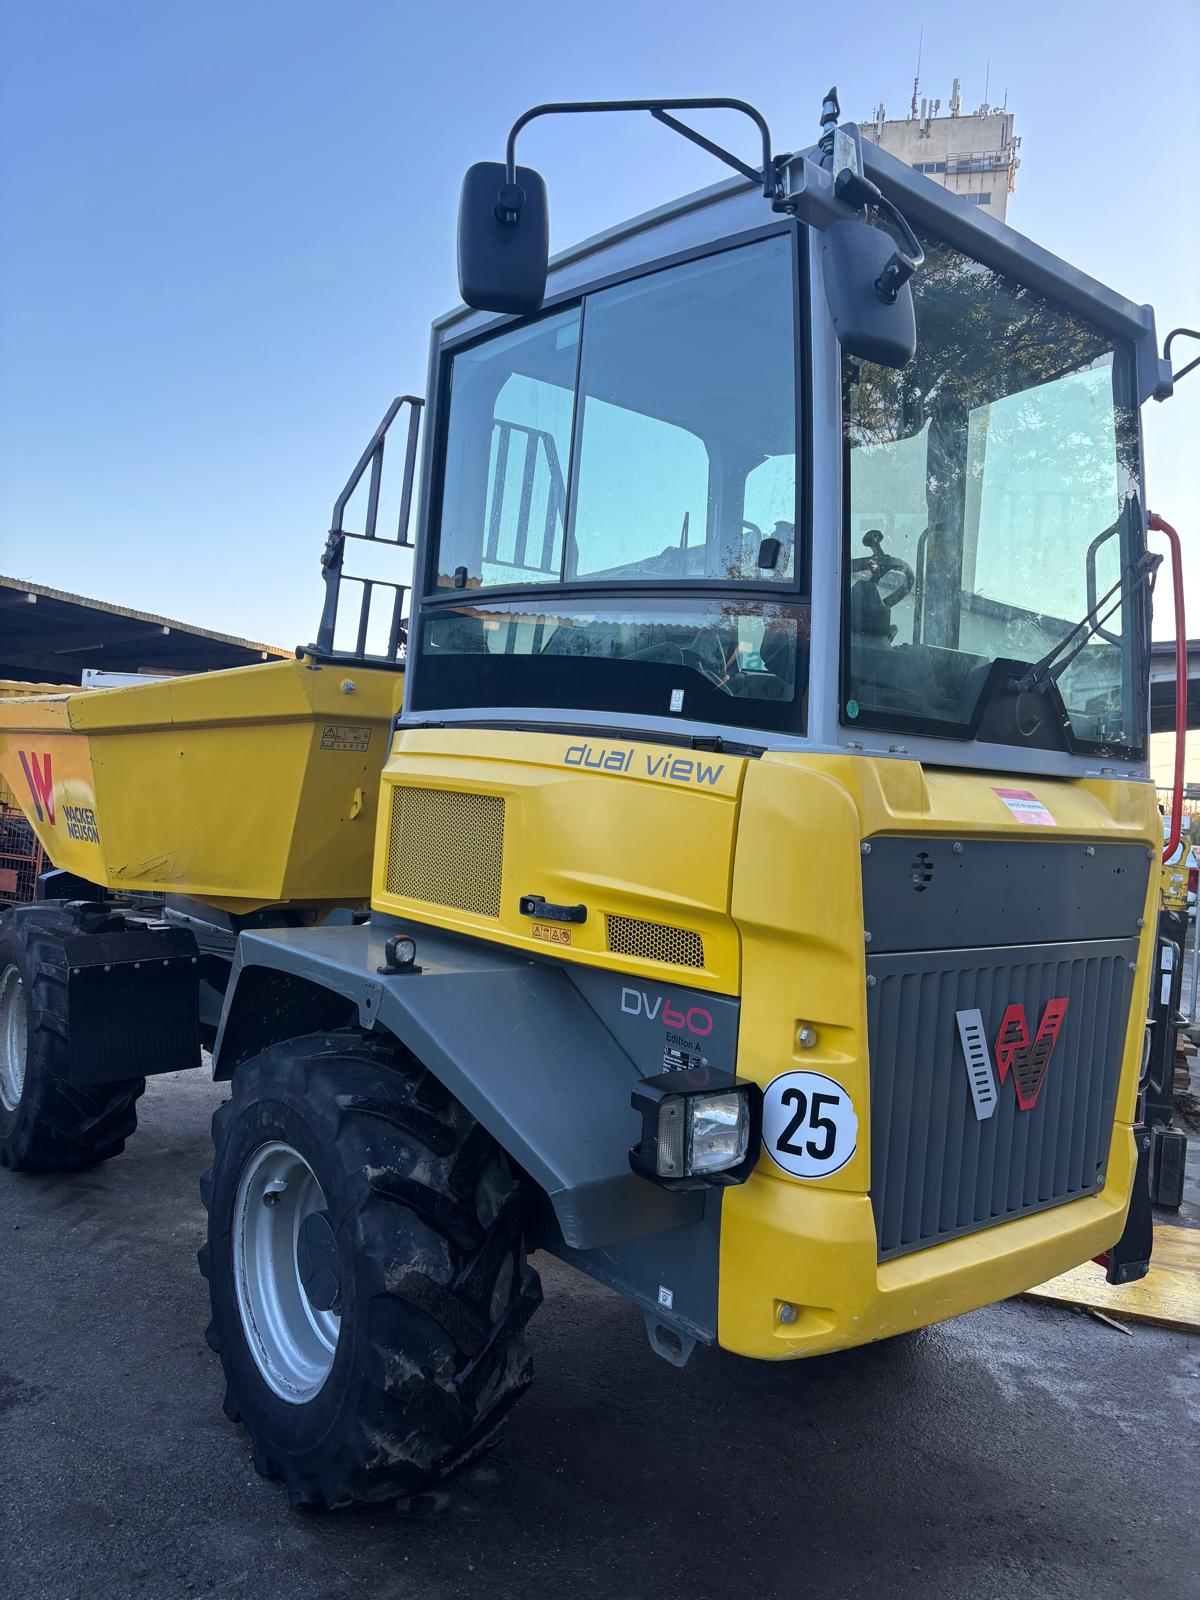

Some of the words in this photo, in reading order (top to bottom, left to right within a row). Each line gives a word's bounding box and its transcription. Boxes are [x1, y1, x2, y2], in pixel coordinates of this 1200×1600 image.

[563, 743, 635, 772] dual
[646, 754, 725, 785] view
[62, 805, 97, 827] WACKER
[66, 822, 100, 845] NEUSON
[620, 987, 714, 1036] DV60
[665, 1031, 693, 1050] Edition
[694, 1042, 702, 1053] A
[776, 1087, 840, 1160] 25
